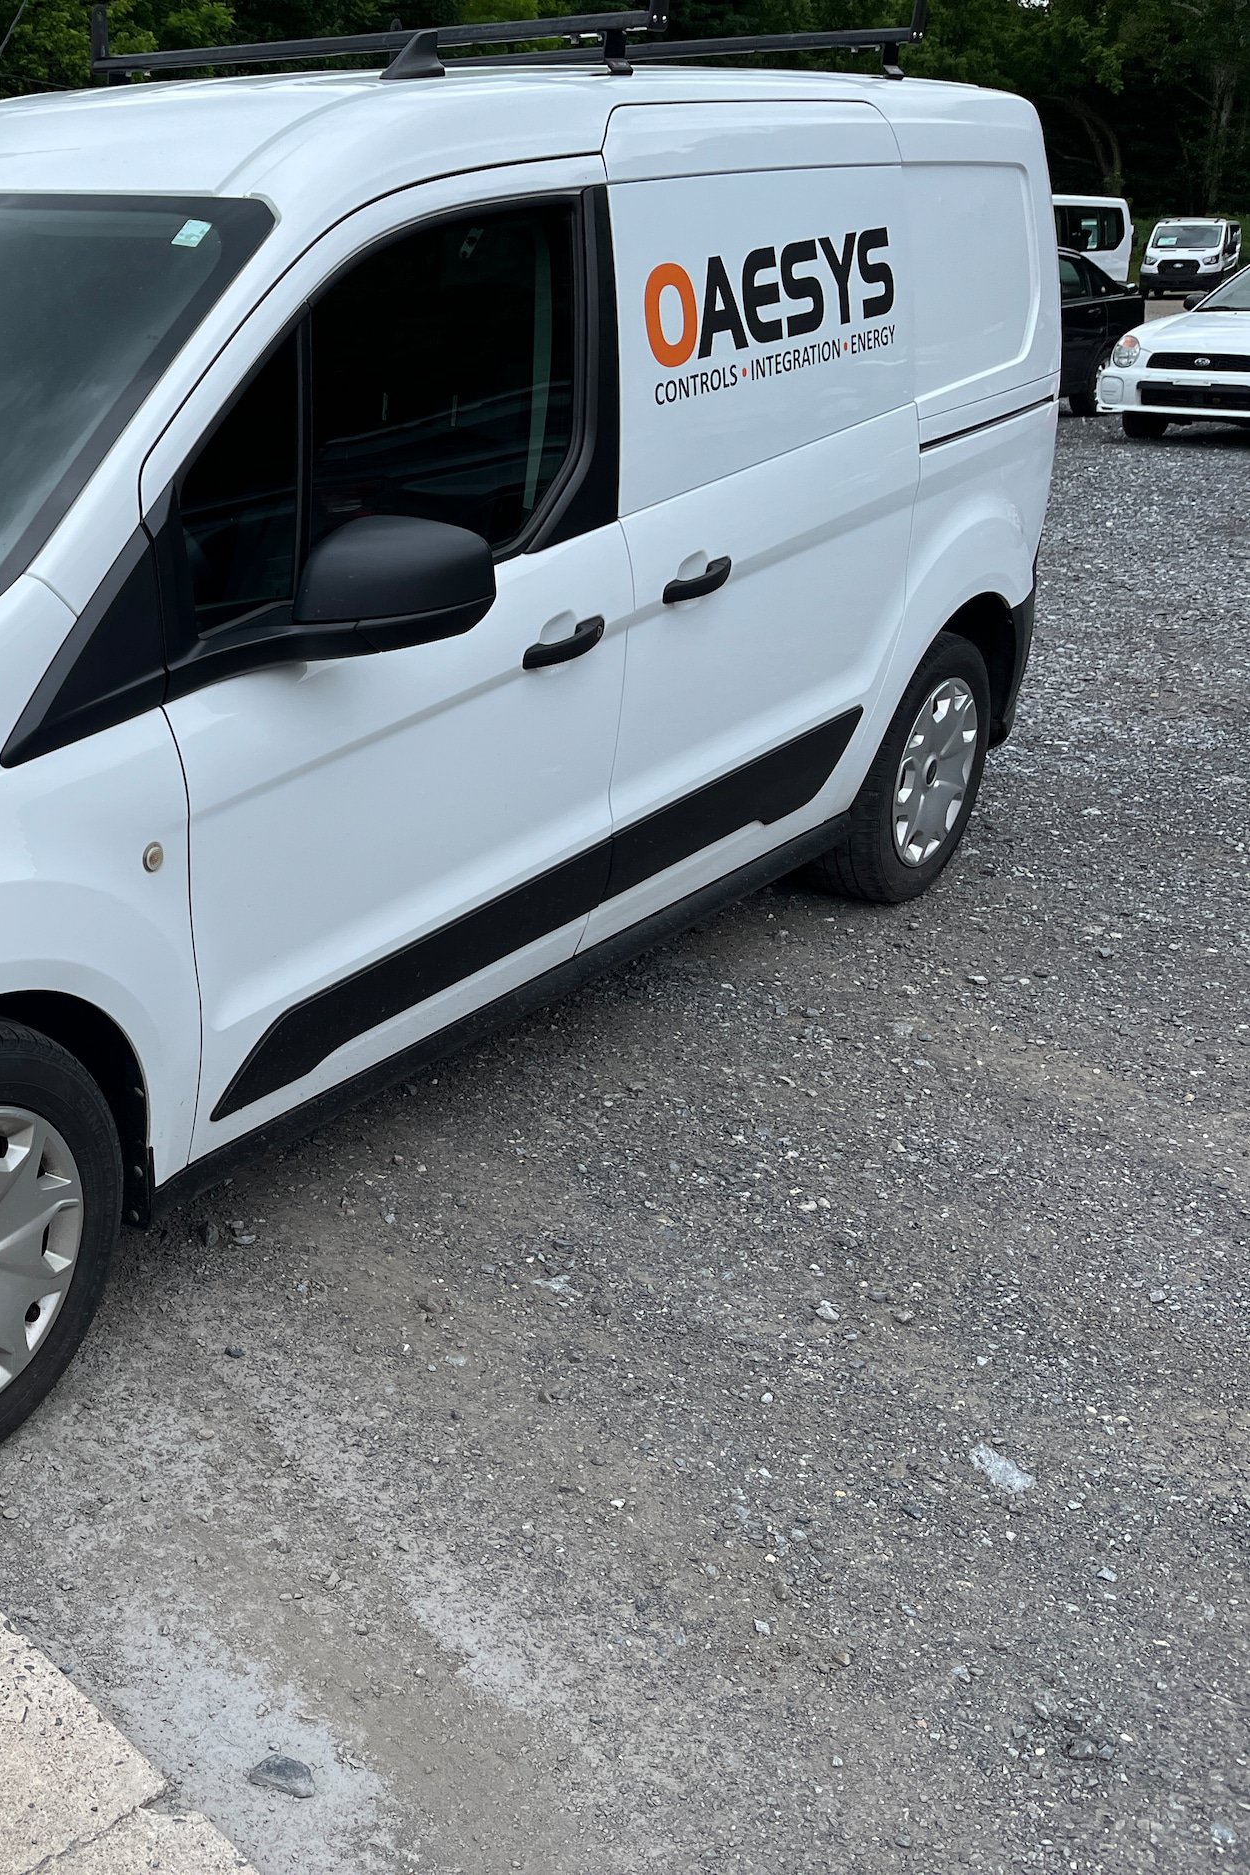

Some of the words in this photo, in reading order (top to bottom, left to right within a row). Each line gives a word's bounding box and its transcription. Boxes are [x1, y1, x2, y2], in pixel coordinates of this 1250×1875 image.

[644, 226, 895, 368] OAESYS
[654, 364, 738, 406] CONTROLS
[750, 338, 842, 381] INTEGRATION
[850, 324, 896, 355] ENERGY
